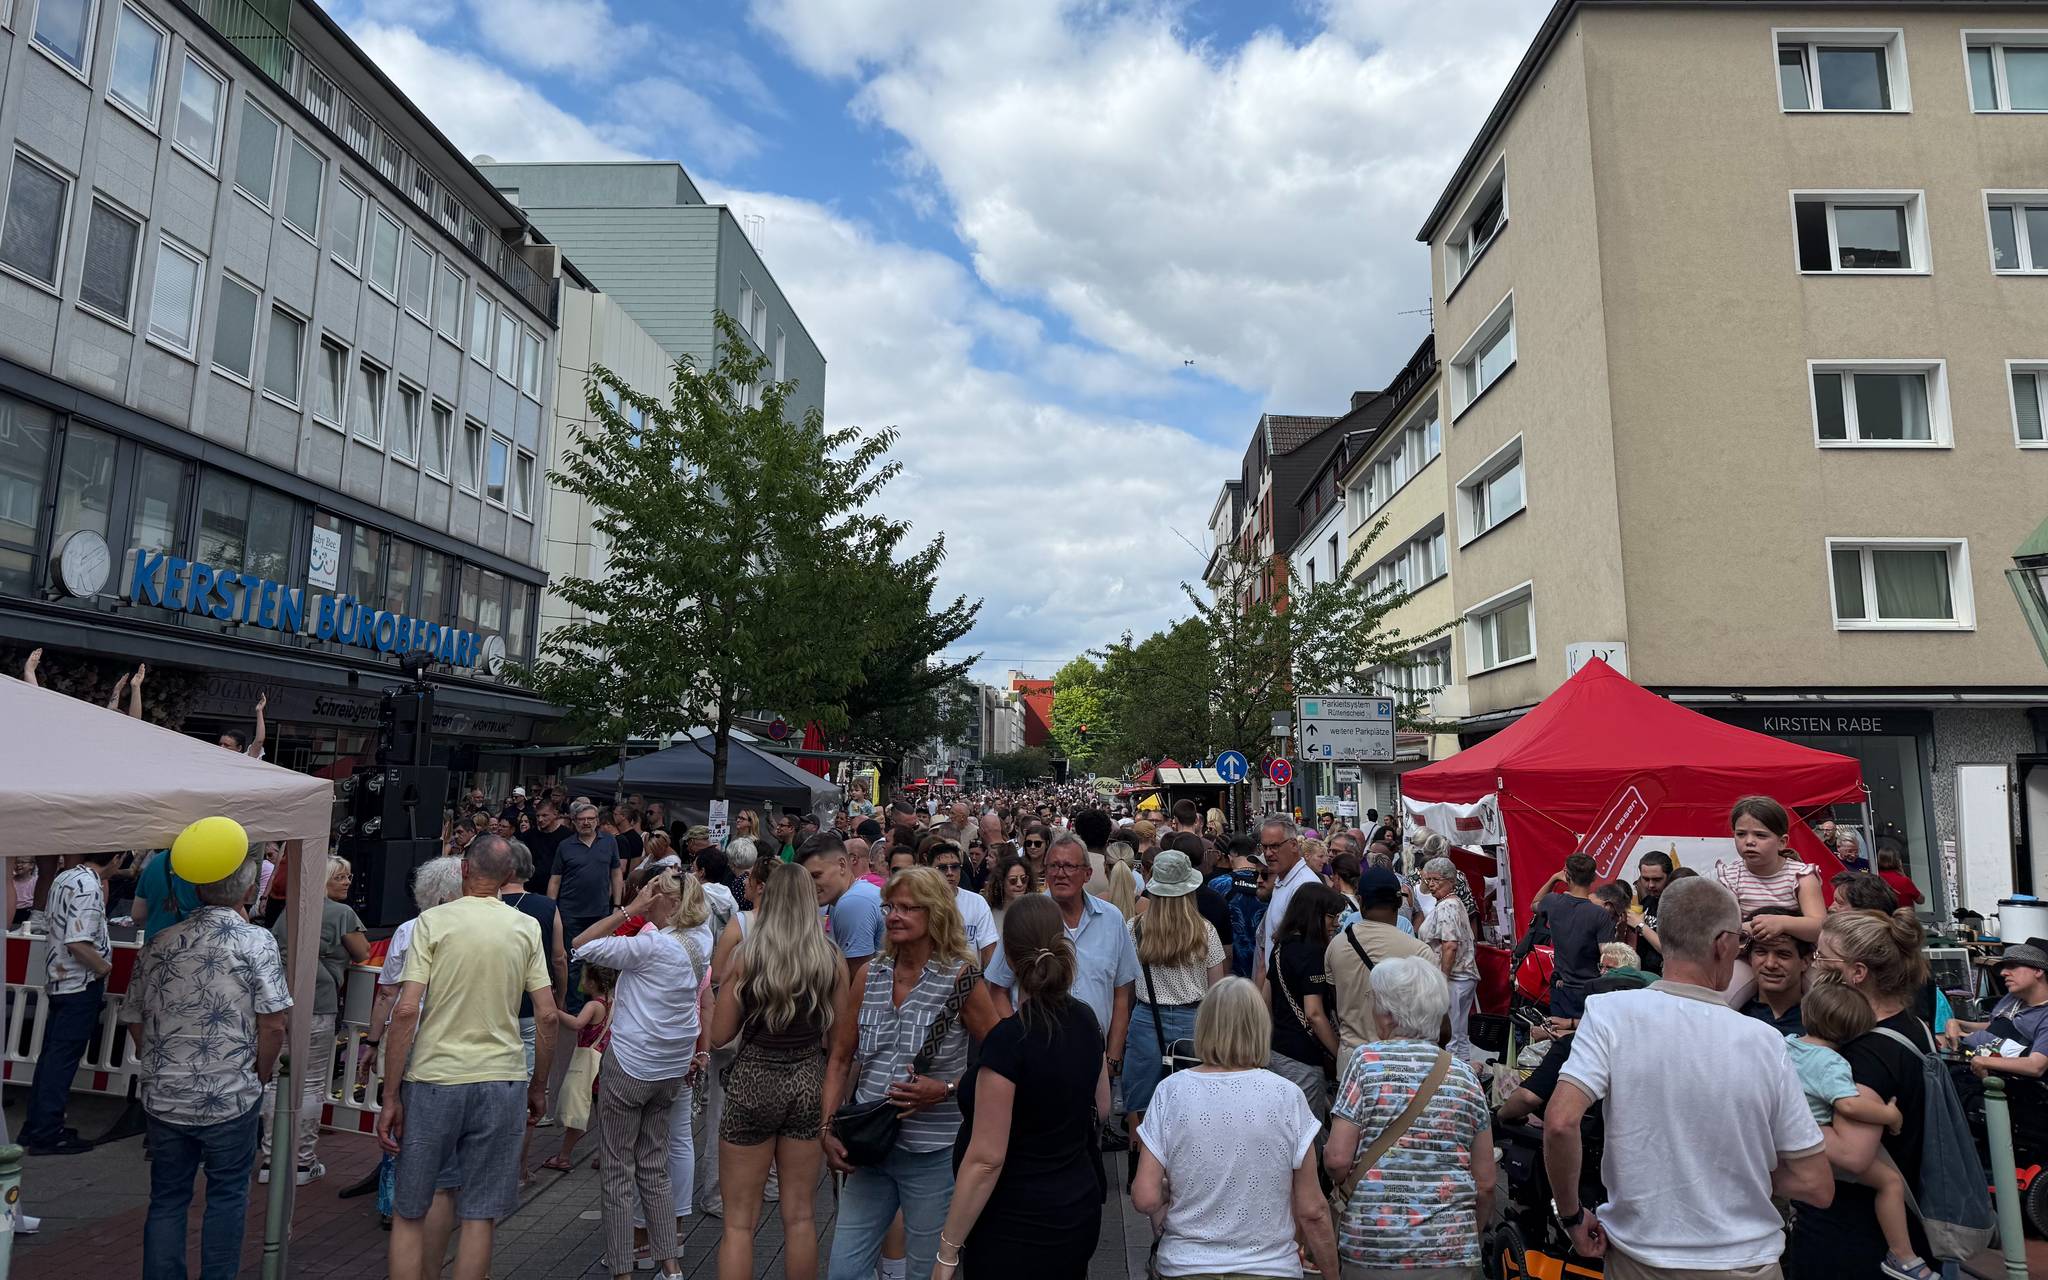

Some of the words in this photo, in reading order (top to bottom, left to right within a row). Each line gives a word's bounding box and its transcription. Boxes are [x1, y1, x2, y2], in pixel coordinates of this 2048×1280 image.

[130, 549, 304, 633] KERSTEN
[316, 593, 482, 668] BÜROBEDARF
[1322, 700, 1371, 709] Parkleitsystem
[432, 714, 454, 728] aren
[1763, 717, 1831, 731] KIRSTEN
[1837, 717, 1883, 732] RABE
[1356, 727, 1390, 736] Parkplätze
[1592, 832, 1614, 860] radio
[1614, 799, 1638, 831] essen
